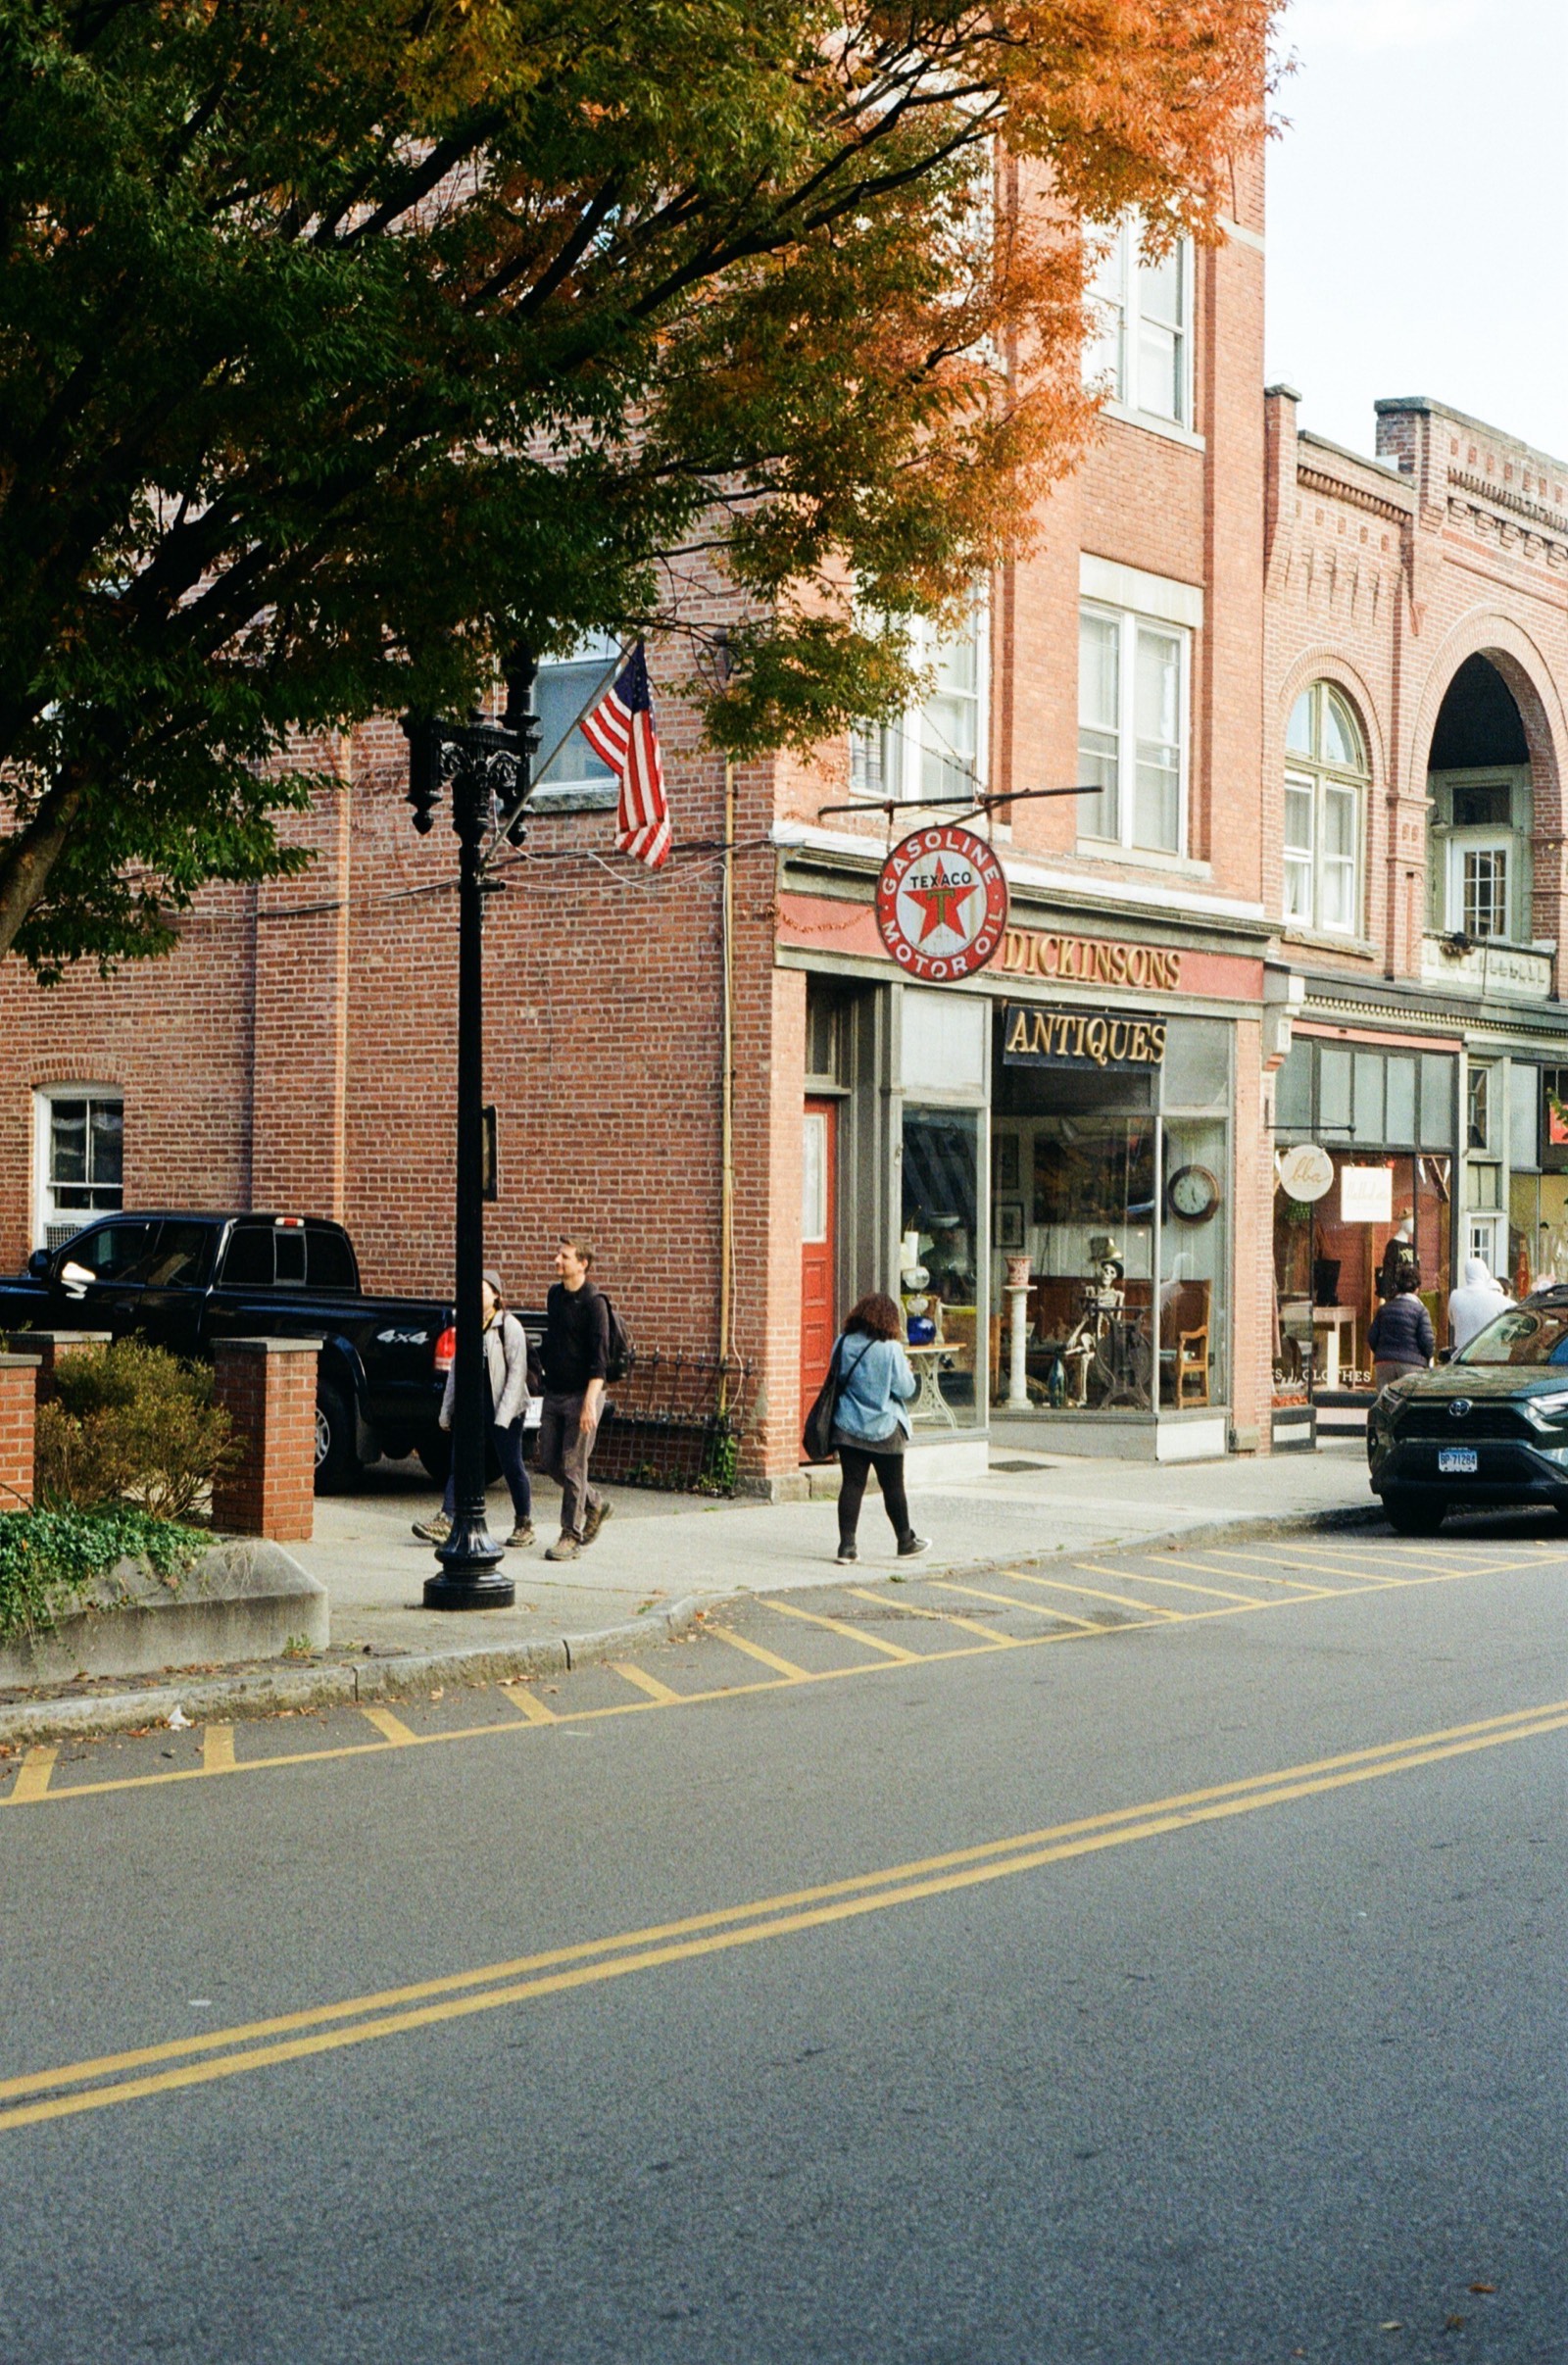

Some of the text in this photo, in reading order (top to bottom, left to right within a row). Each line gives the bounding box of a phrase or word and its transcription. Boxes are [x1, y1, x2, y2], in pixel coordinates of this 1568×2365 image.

[882, 831, 1001, 895] GASOLINE
[909, 871, 972, 889] TEXACO
[882, 908, 1004, 978] MOTOR OIL
[1003, 930, 1181, 991] DICKINSONS
[1006, 1010, 1167, 1066] ANTIQUES
[376, 1329, 429, 1345] 4x4
[1302, 1368, 1371, 1383] CLOHES
